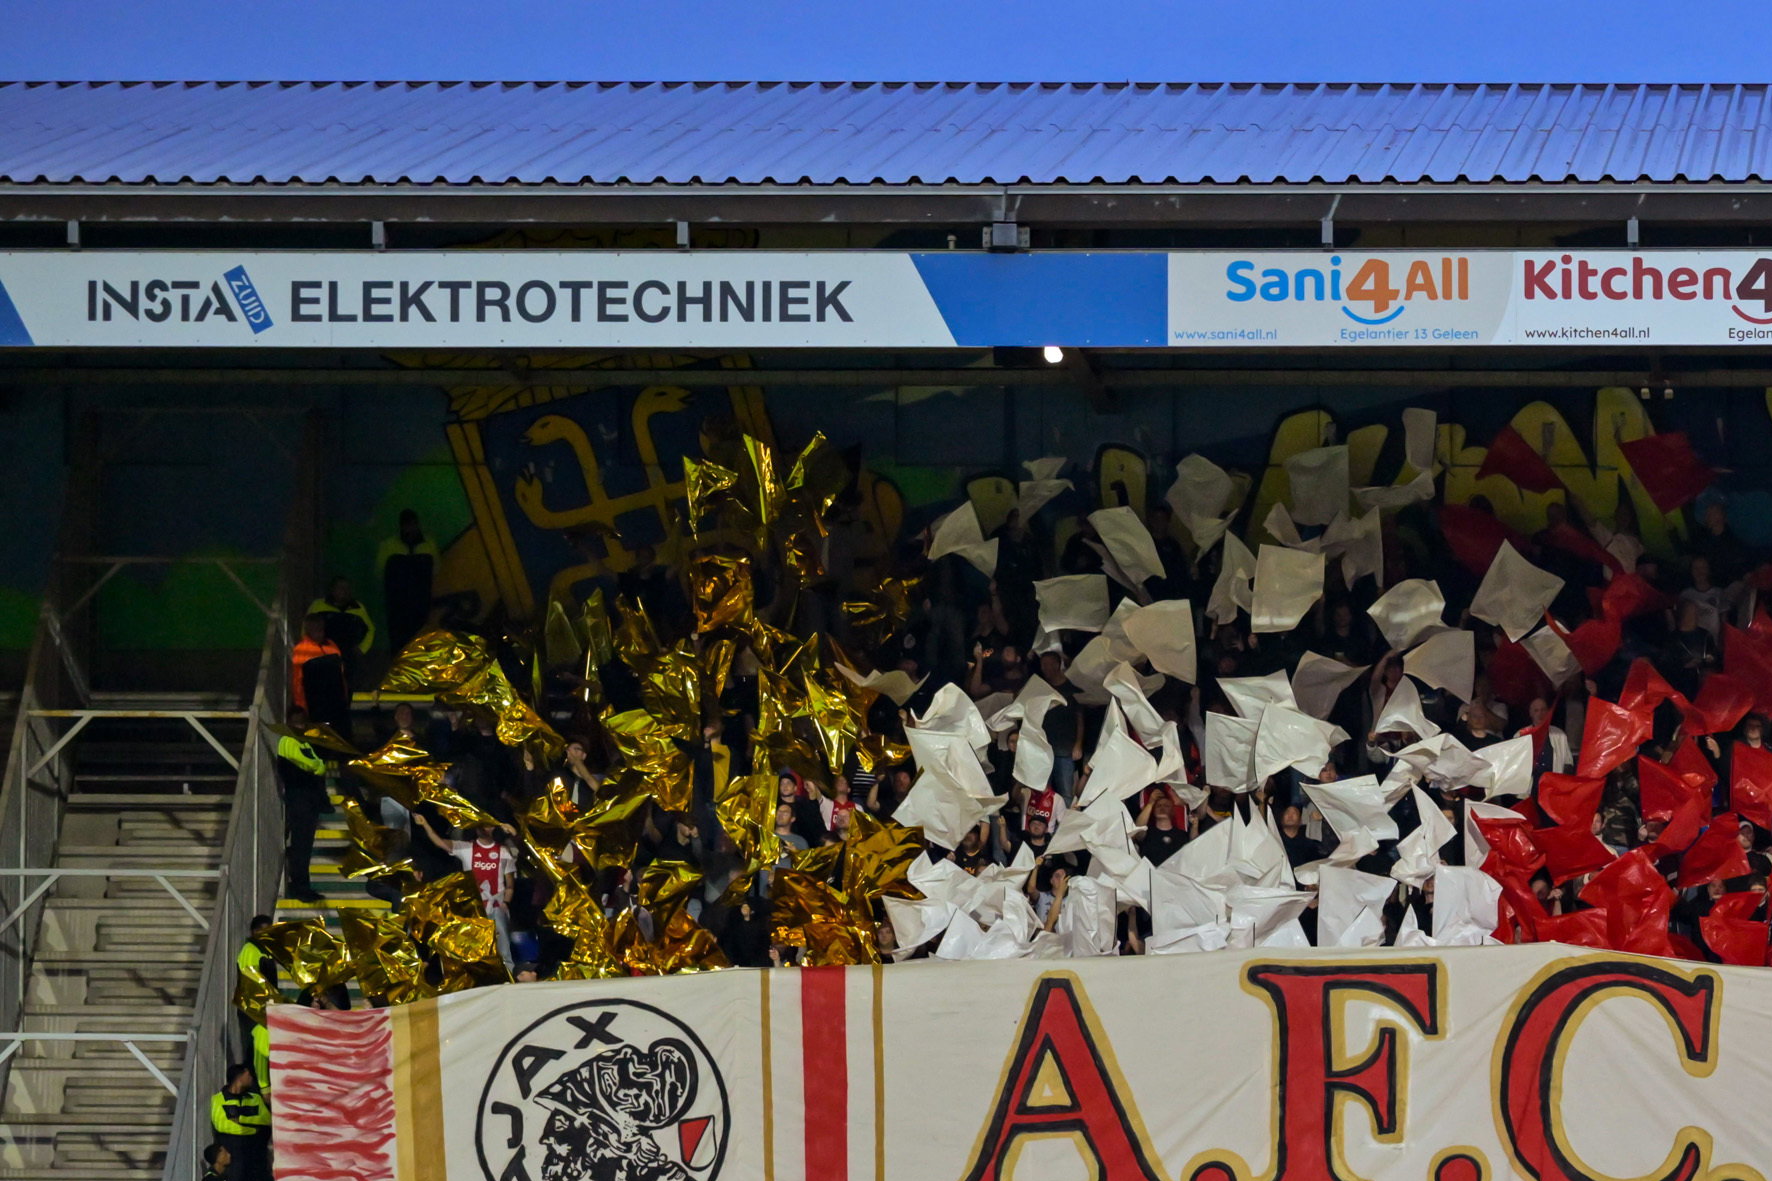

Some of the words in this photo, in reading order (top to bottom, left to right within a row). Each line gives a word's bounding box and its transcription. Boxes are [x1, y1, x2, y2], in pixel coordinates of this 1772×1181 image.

[1226, 256, 1469, 313] Sani4All
[87, 280, 237, 323] INSTA
[228, 271, 271, 330] ZUID
[289, 280, 854, 324] ELEKTROTECHNIEK
[1174, 328, 1278, 342] www.sani4all.nl
[1340, 327, 1410, 343] Egelantier
[1414, 328, 1428, 340] 13
[1432, 327, 1479, 340] Geleen
[1525, 327, 1650, 342] www.kitchen4all.nl
